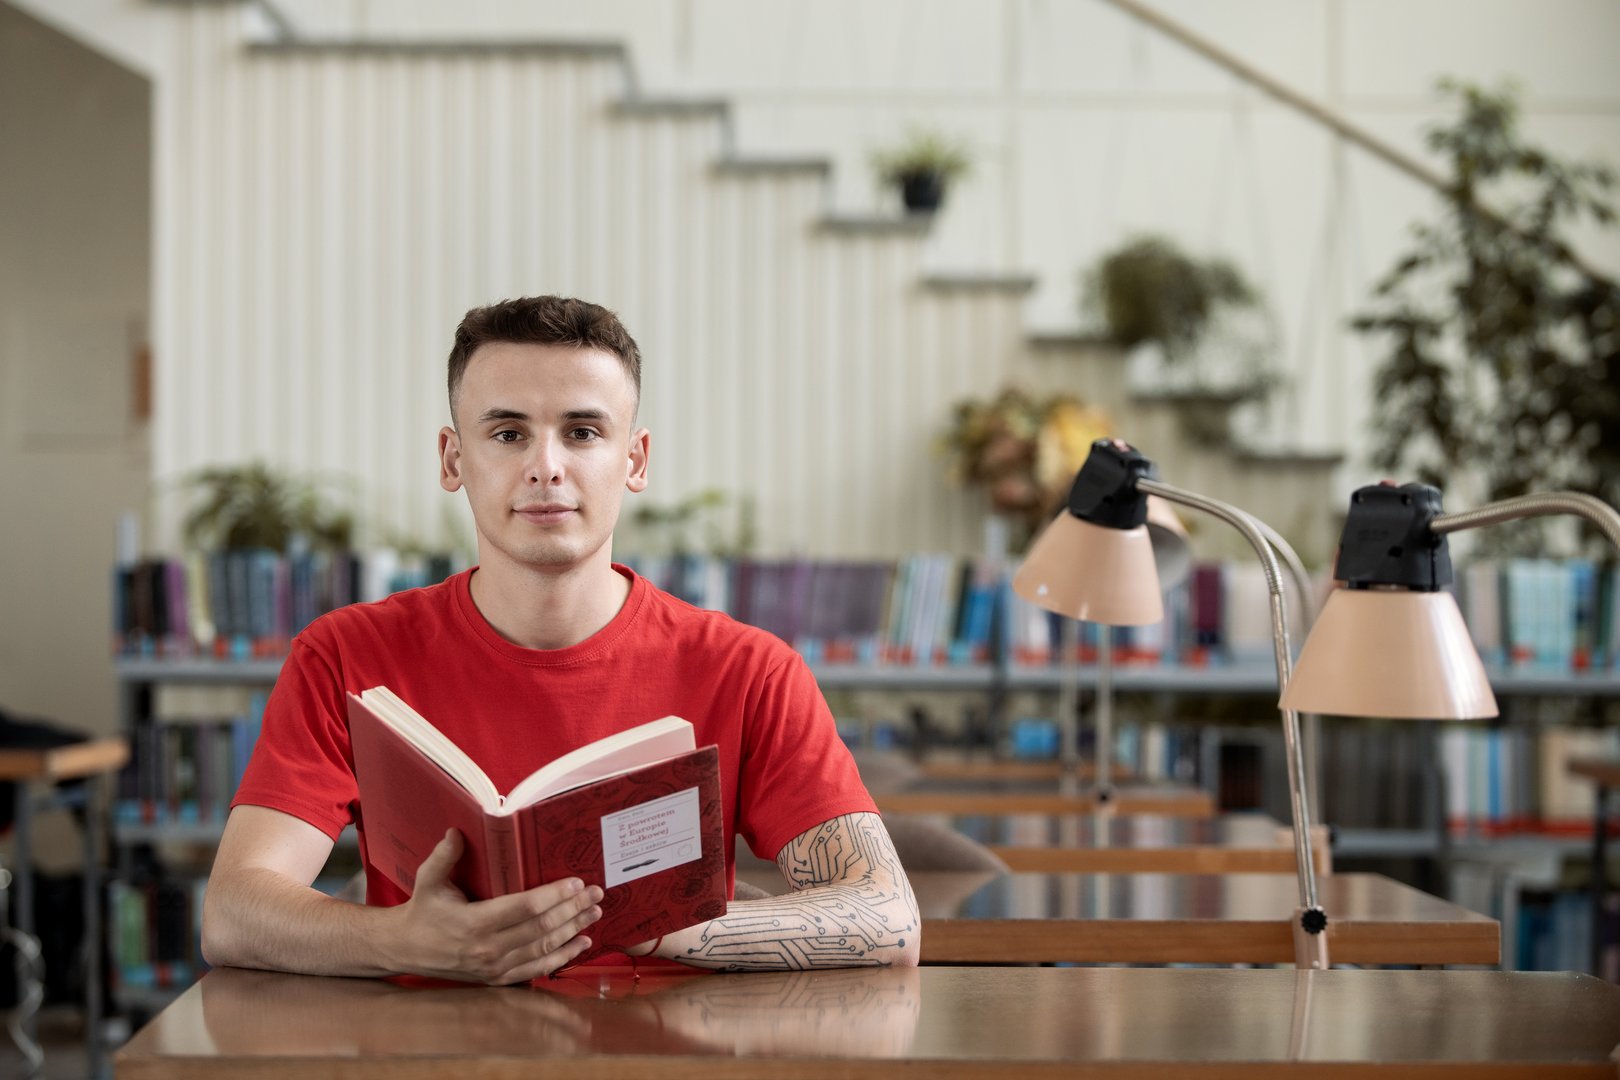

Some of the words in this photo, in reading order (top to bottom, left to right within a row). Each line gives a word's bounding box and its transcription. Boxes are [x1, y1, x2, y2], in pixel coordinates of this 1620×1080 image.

[628, 809, 675, 829] powrotem
[629, 821, 666, 837] Europie
[620, 827, 669, 848] Środkowej
